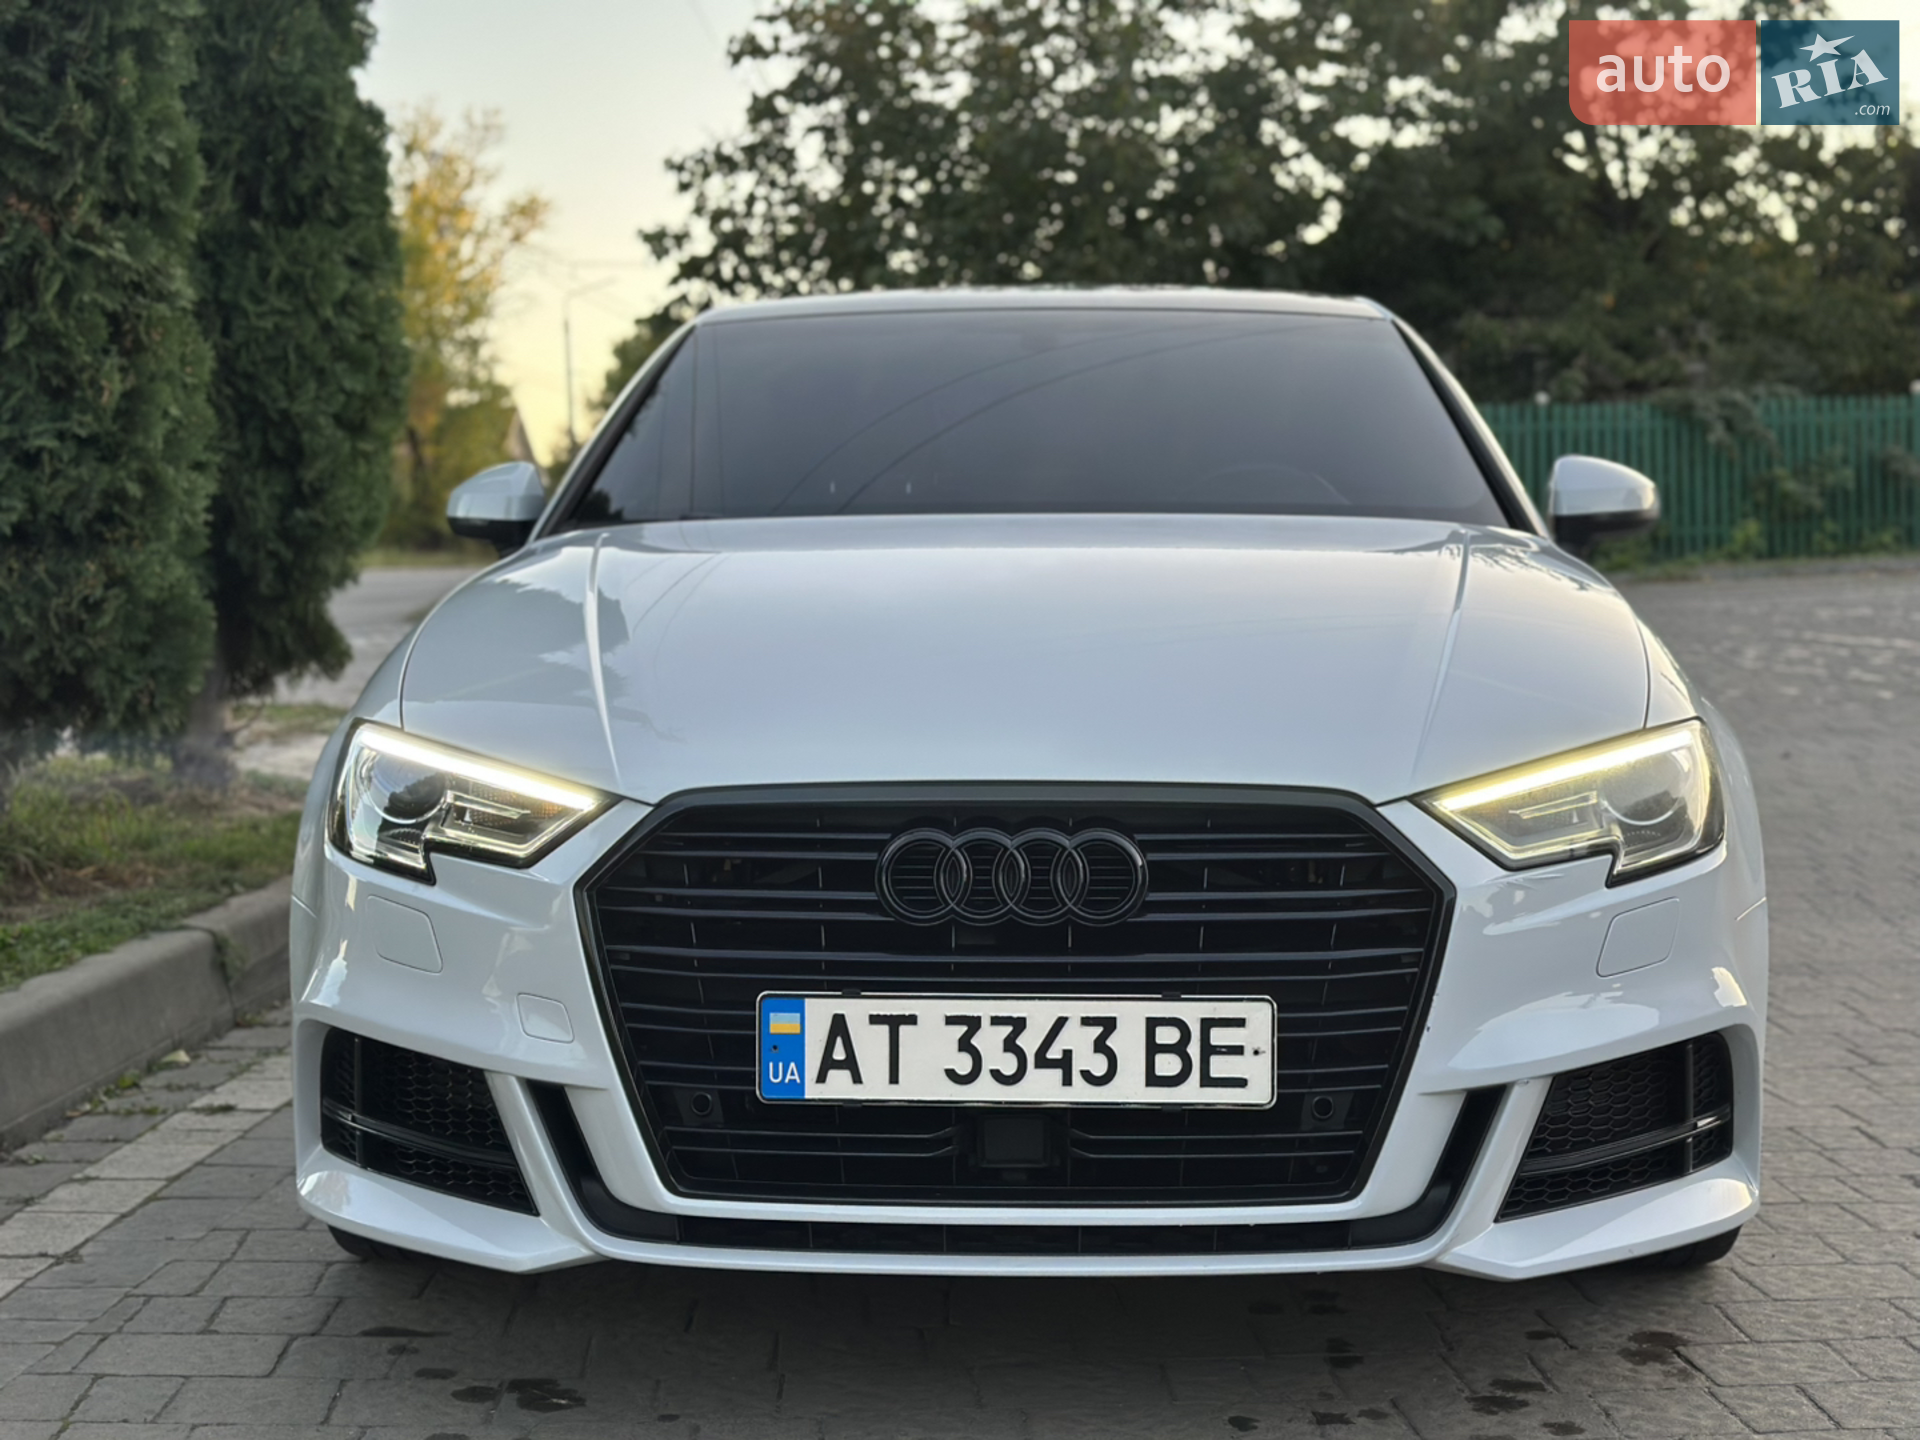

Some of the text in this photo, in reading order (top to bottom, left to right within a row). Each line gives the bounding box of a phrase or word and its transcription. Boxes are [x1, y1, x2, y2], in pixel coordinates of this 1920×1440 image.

[768, 1061, 801, 1084] UA
[815, 1013, 1249, 1089] AT 3343 BE
